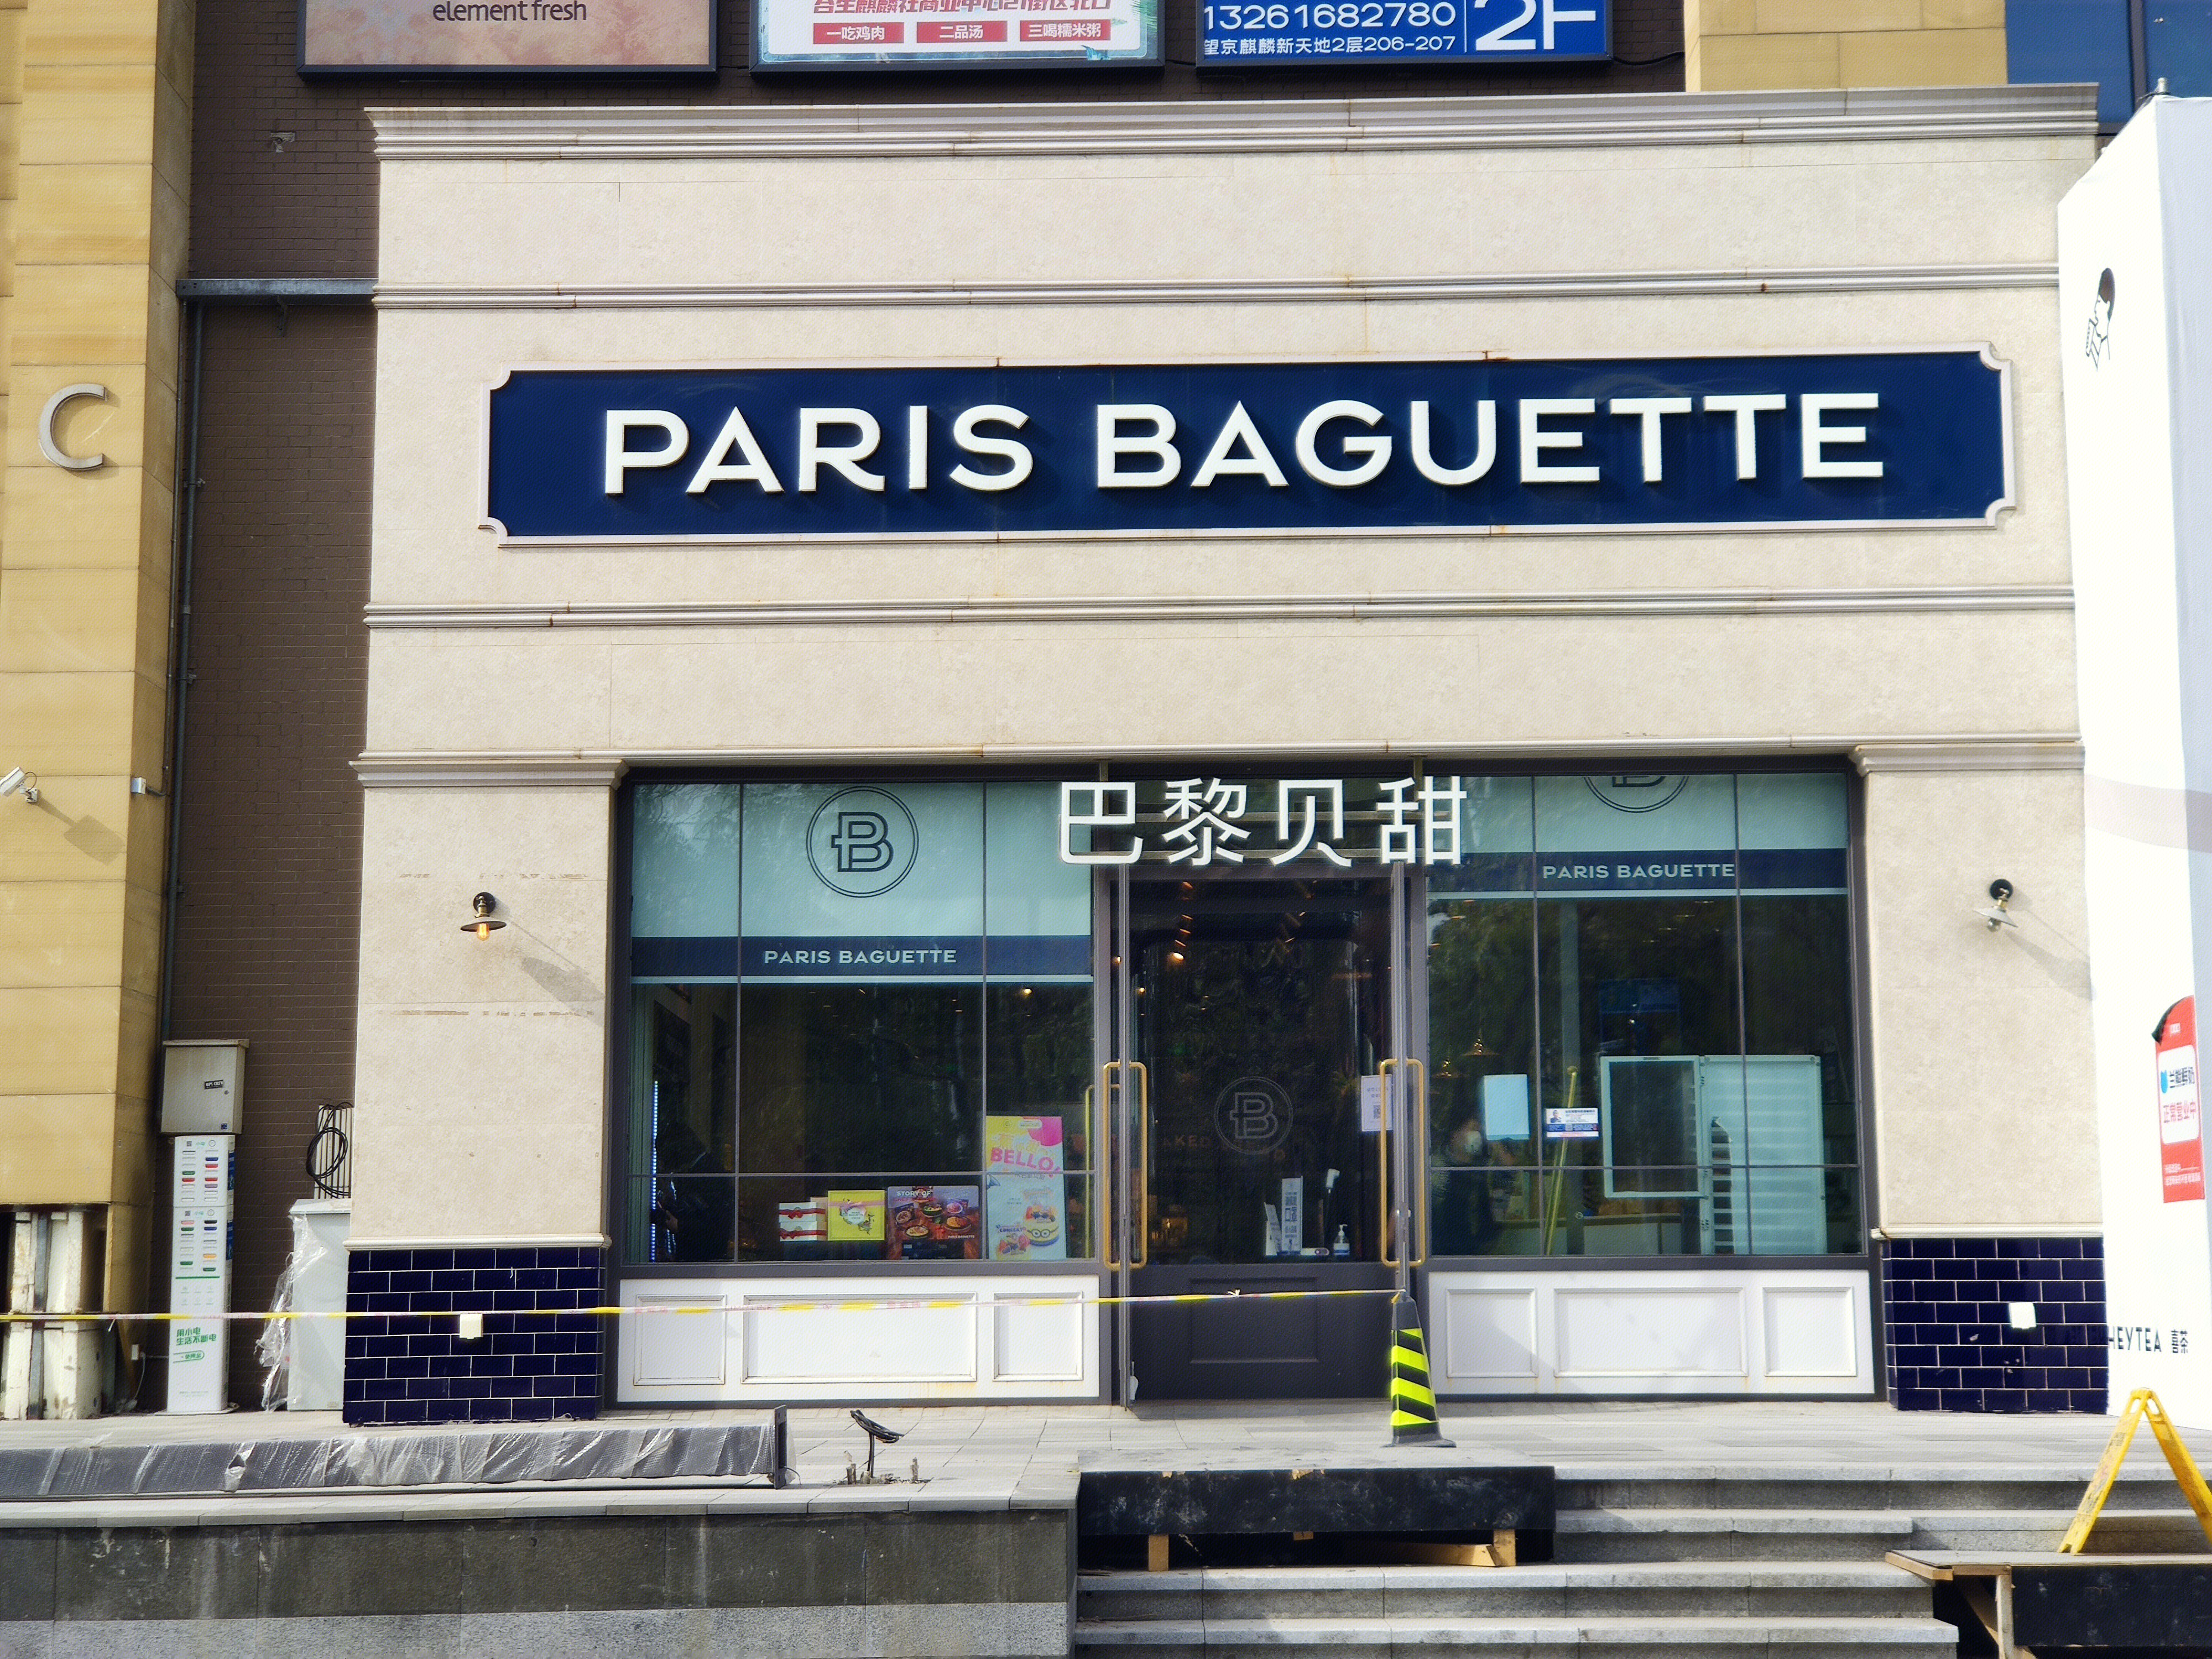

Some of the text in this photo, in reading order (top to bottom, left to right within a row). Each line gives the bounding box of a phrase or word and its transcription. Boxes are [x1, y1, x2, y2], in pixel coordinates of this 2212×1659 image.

[432, 0, 587, 21] element fresh
[1204, 3, 1456, 30] 13261682780
[827, 26, 885, 40] 一吃鸡肉
[940, 24, 983, 39] 二品汤
[1028, 23, 1101, 38] 三喝糯米粥
[1474, 0, 1596, 50] 2F
[1204, 36, 1456, 55] 望京麒麟新天地2层206-207
[40, 383, 106, 469] C
[605, 393, 1885, 494] PARIS BAGUETTE
[1059, 776, 1468, 867] 巴黎贝甜
[1542, 863, 1735, 879] PARIS BAGUETTE
[764, 949, 957, 964] PARIS BAGUETTE
[2108, 1326, 2162, 1353] HEYTEA
